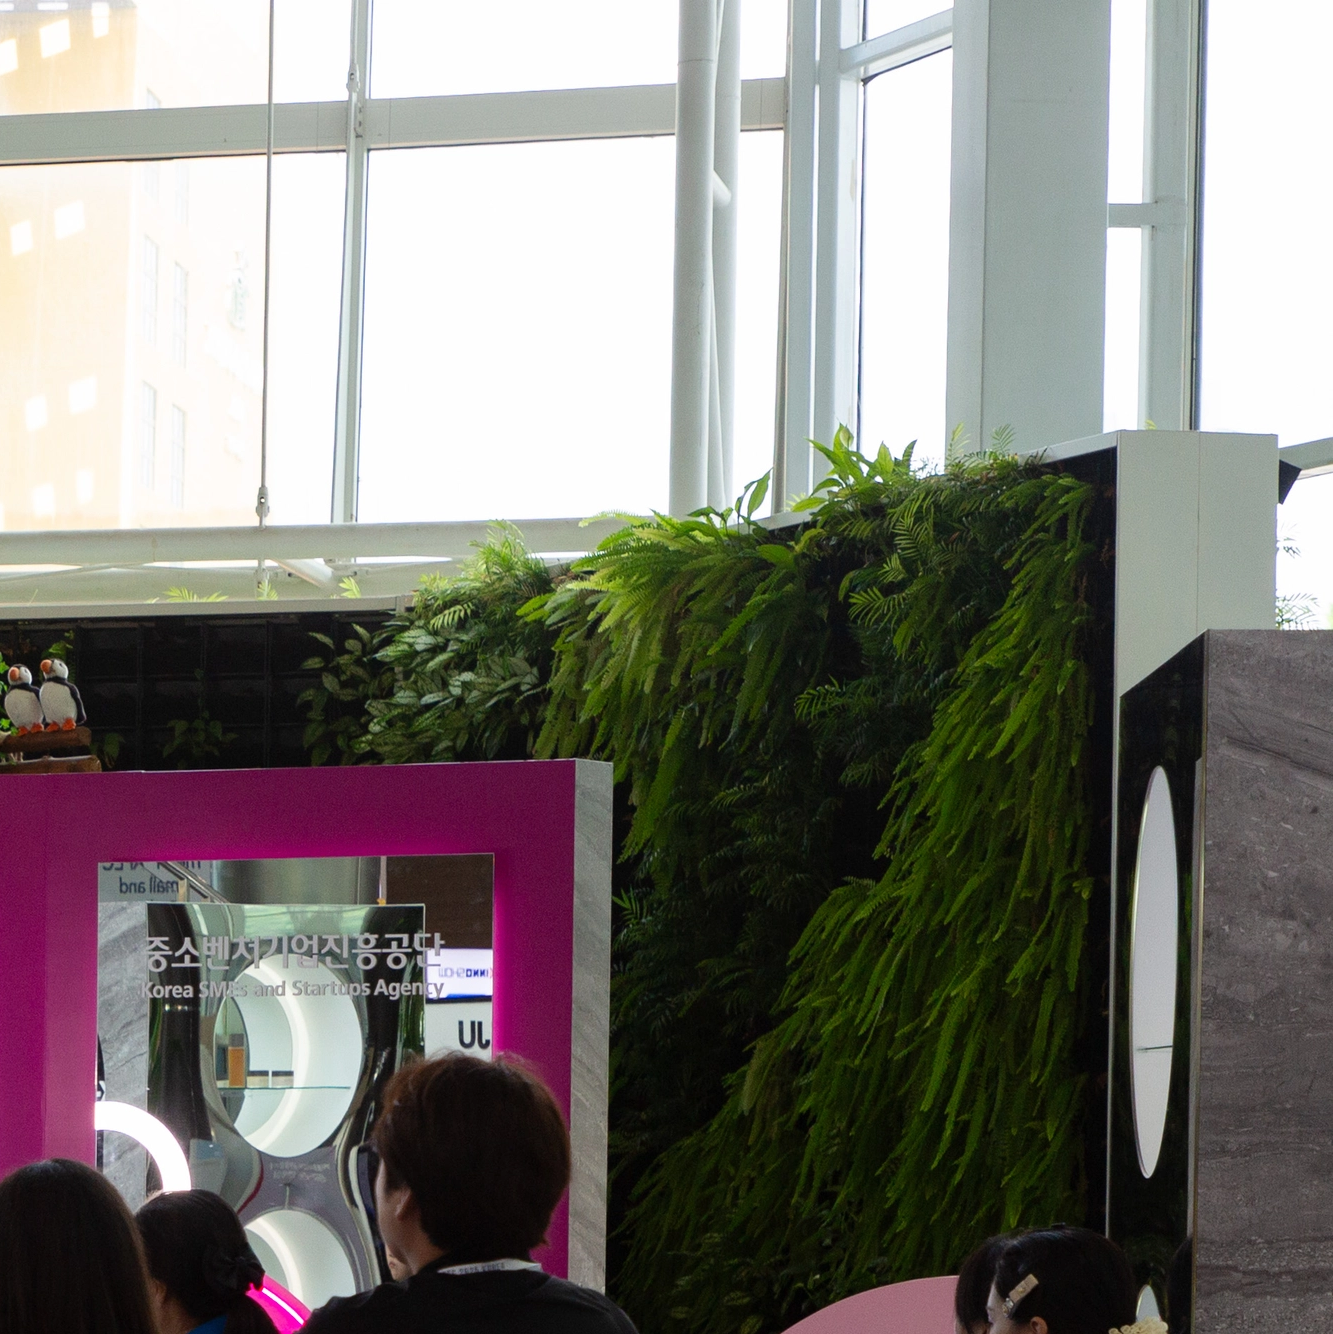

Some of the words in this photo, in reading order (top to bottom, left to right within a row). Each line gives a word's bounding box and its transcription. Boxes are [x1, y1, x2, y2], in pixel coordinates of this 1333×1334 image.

[145, 932, 445, 971] 중소벤처기업진흥공단
[141, 981, 194, 999] Korea
[199, 980, 247, 998] SMEs
[253, 979, 286, 997] and
[292, 979, 370, 1000] Startups
[374, 979, 445, 1000] Agency
